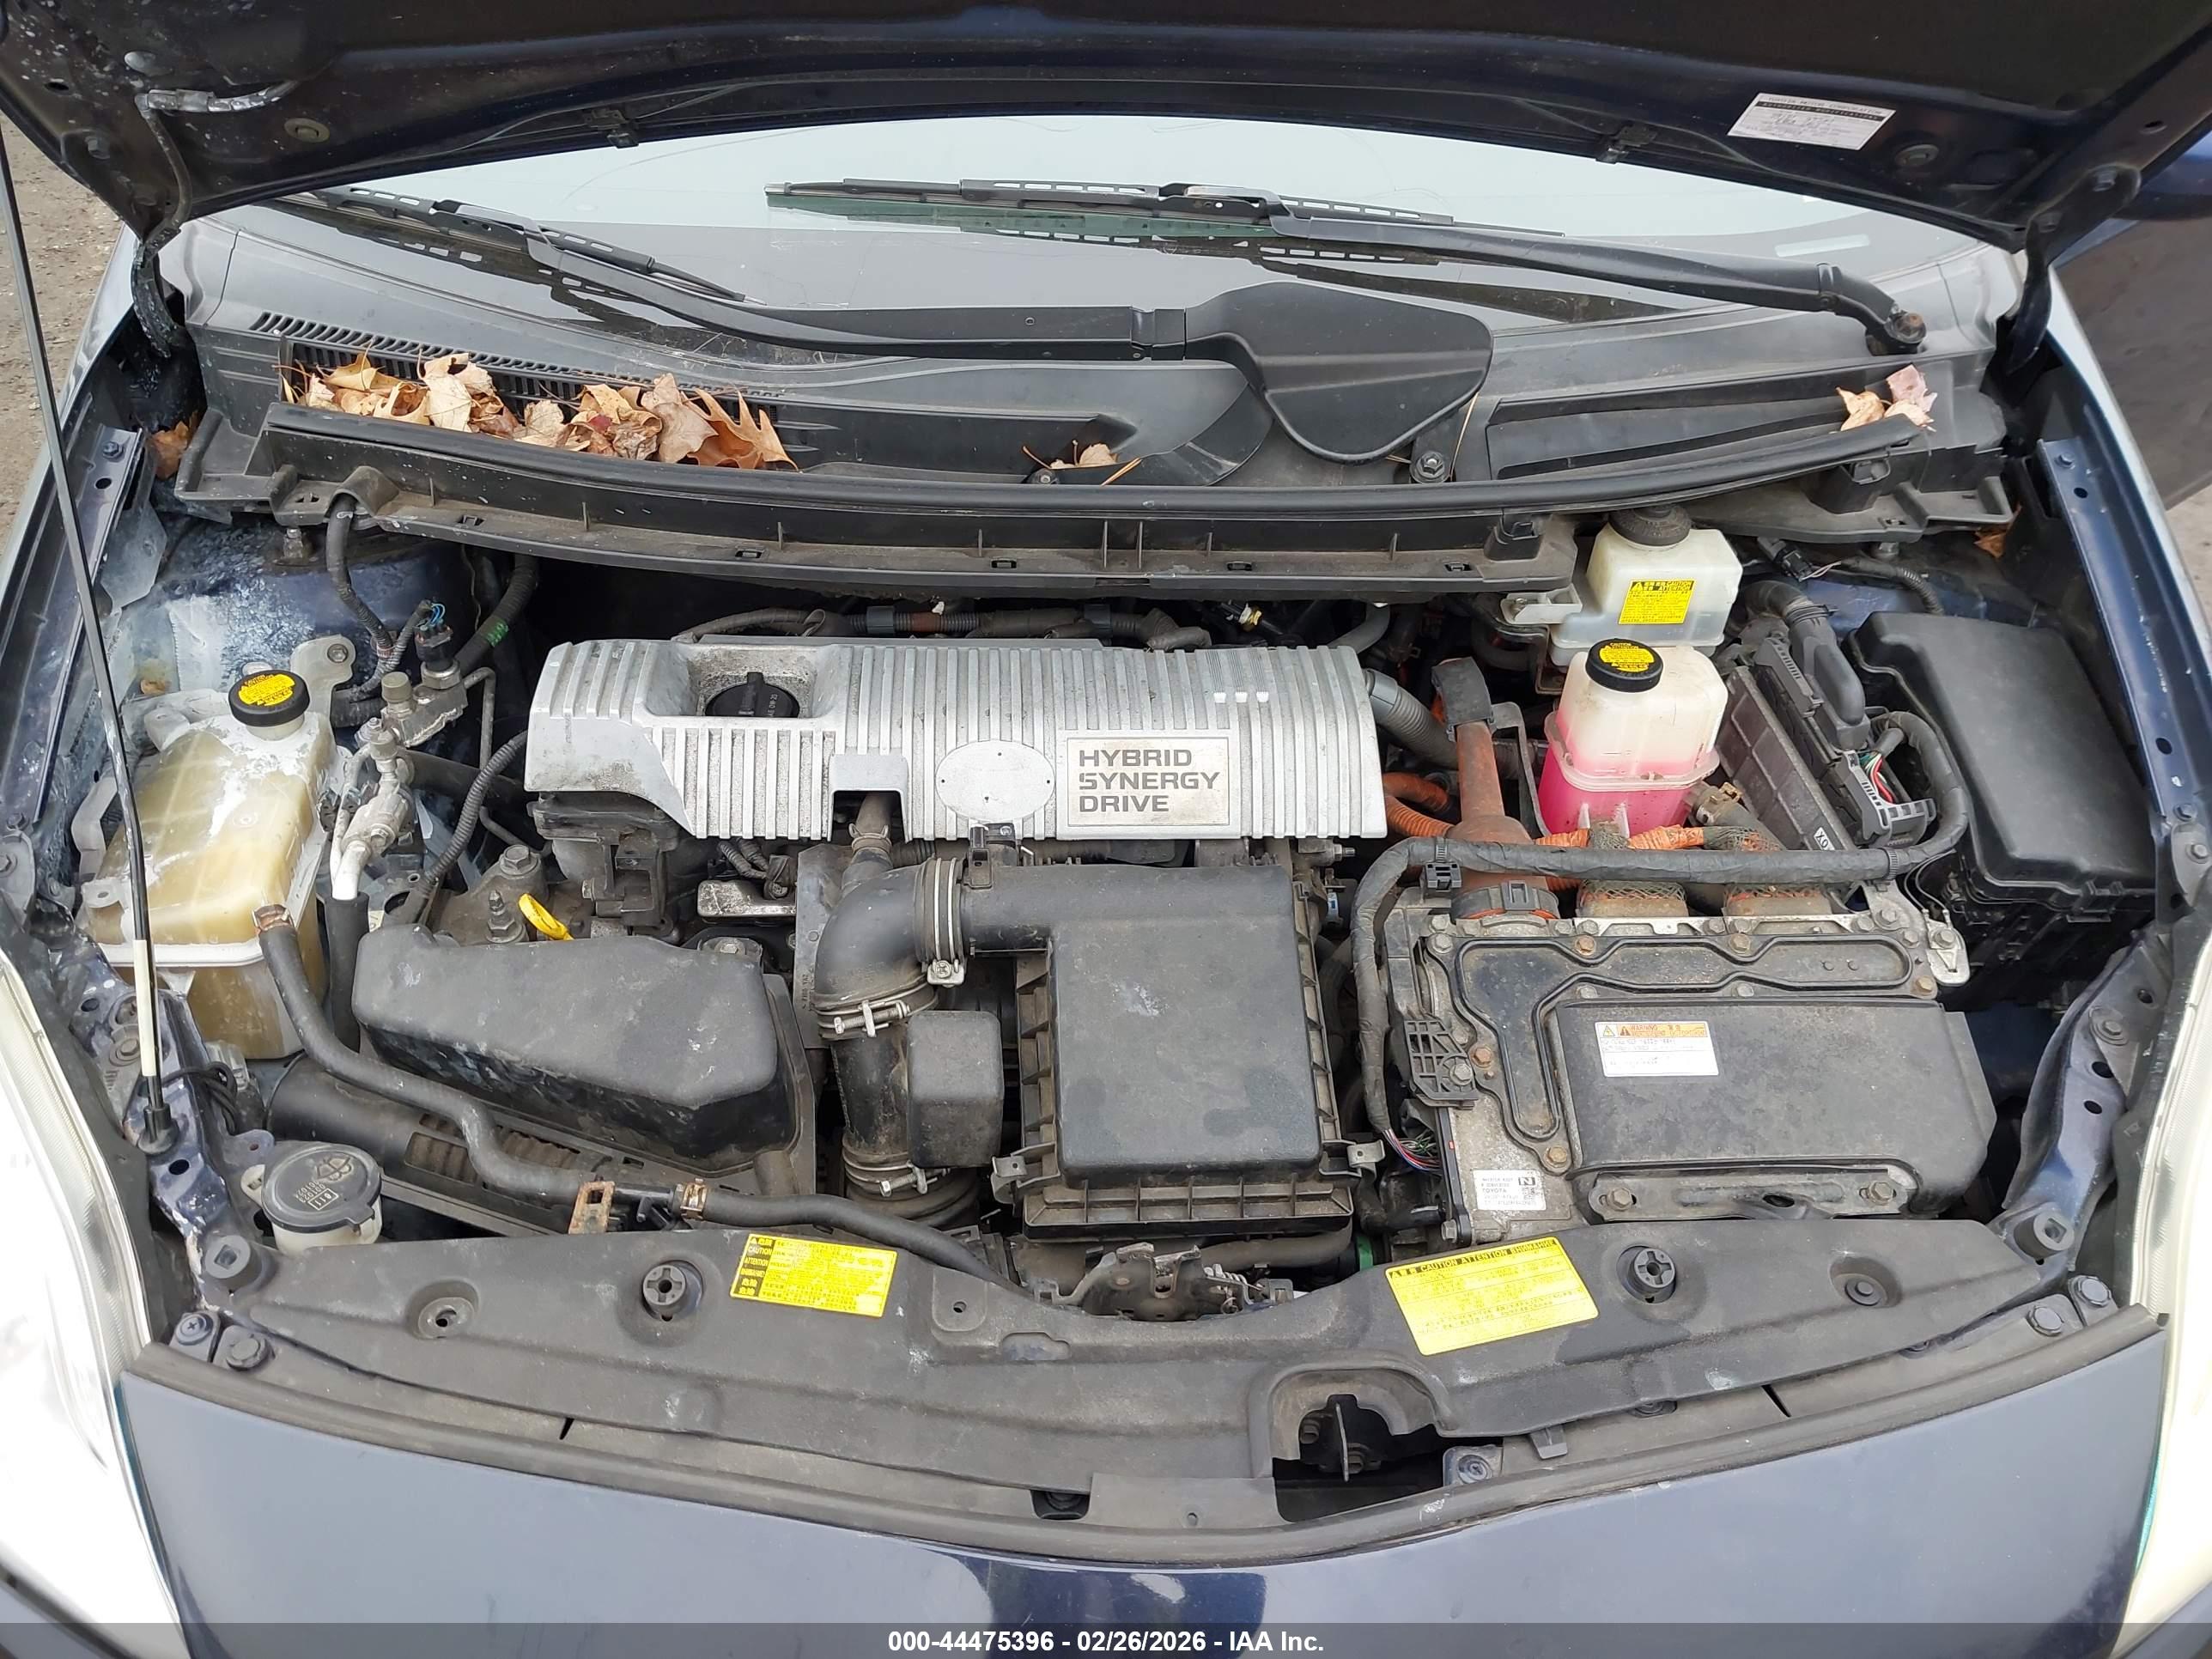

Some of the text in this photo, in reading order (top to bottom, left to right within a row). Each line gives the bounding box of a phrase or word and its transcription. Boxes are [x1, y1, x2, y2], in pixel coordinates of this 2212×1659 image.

[1079, 750, 1191, 767] HYBRID
[1079, 772, 1220, 789] SYNERGY
[1079, 795, 1170, 812] DRIVE
[748, 1246, 772, 1256] CAUTION
[744, 1257, 769, 1267] ATTENTION
[1420, 1261, 1457, 1272] CAUTION
[1462, 1250, 1507, 1264] ATTENTION
